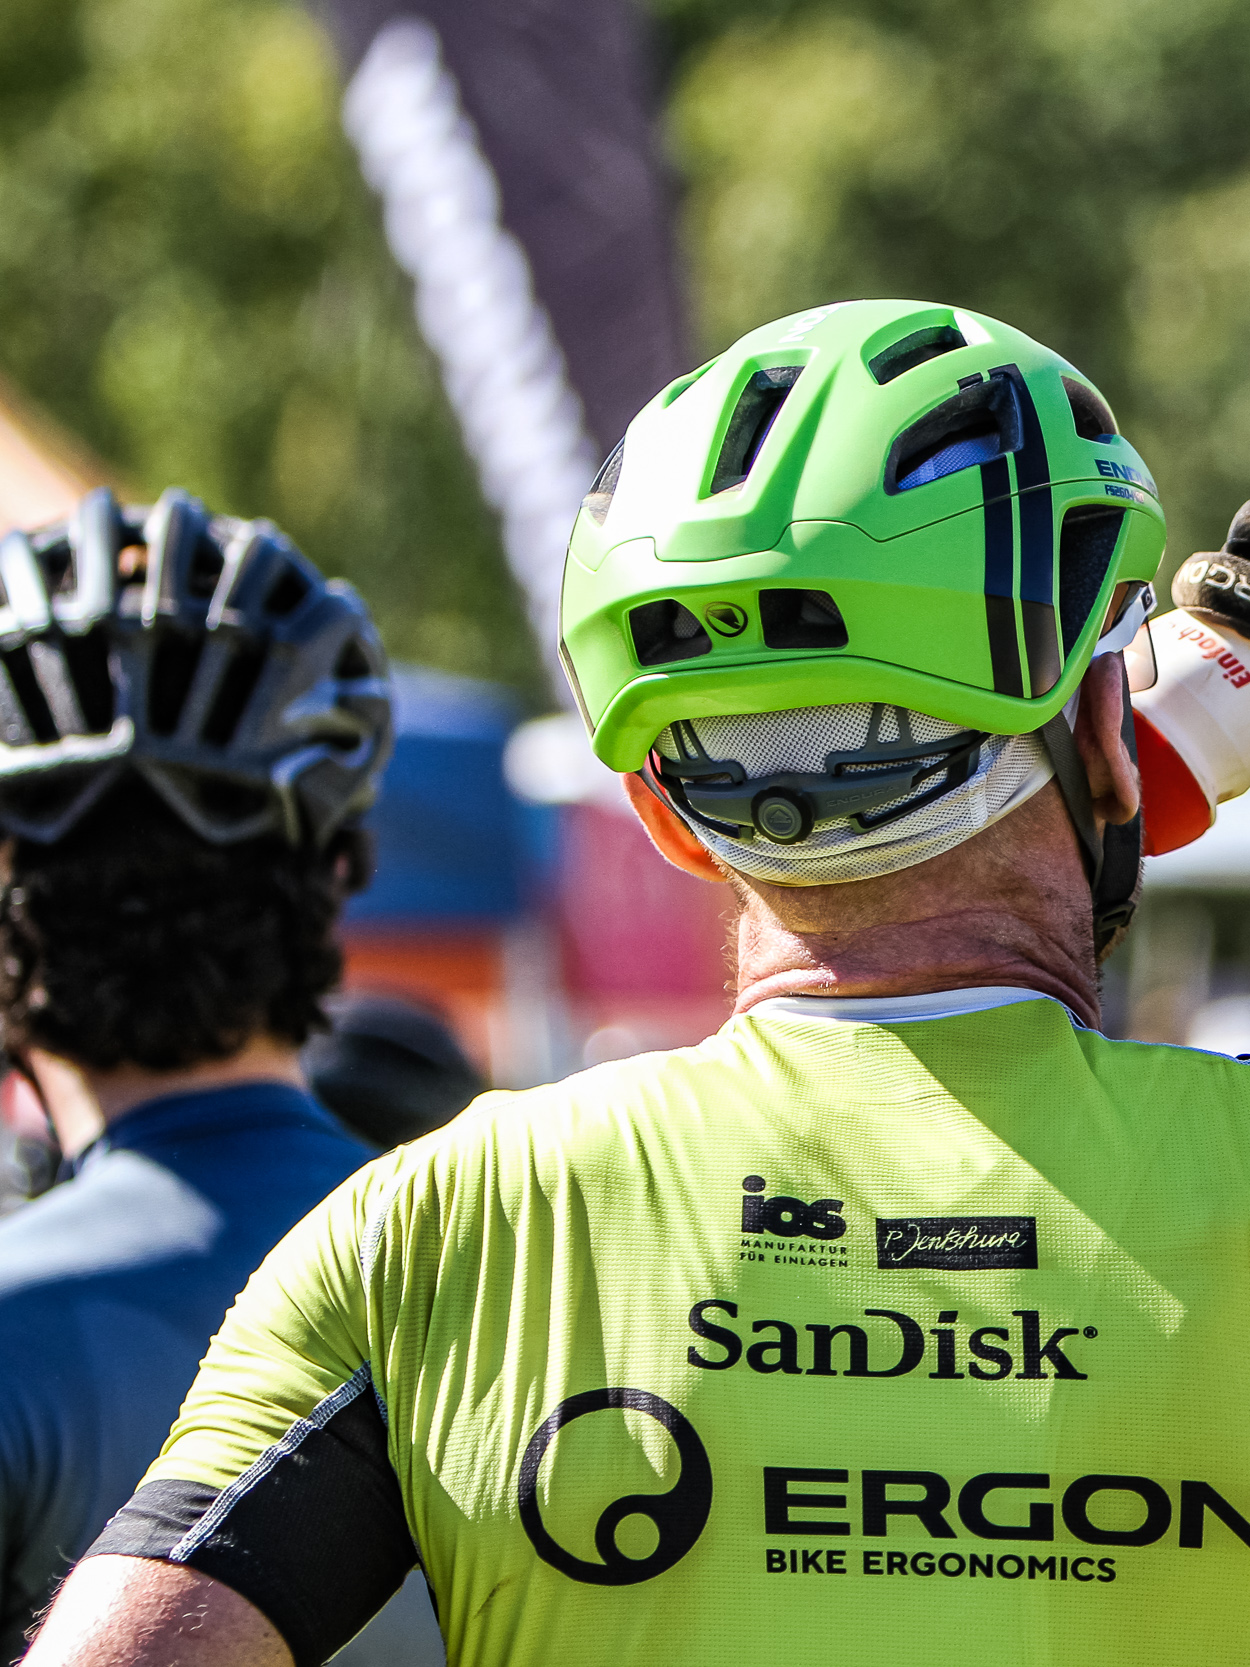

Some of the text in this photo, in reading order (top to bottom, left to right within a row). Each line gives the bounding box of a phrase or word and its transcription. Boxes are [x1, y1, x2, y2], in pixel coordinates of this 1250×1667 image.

[740, 1239, 847, 1255] MANUFAKTUR
[740, 1251, 848, 1268] FÜR EINLAGEN
[766, 1549, 1117, 1583] BIKE ERGONOMICS
